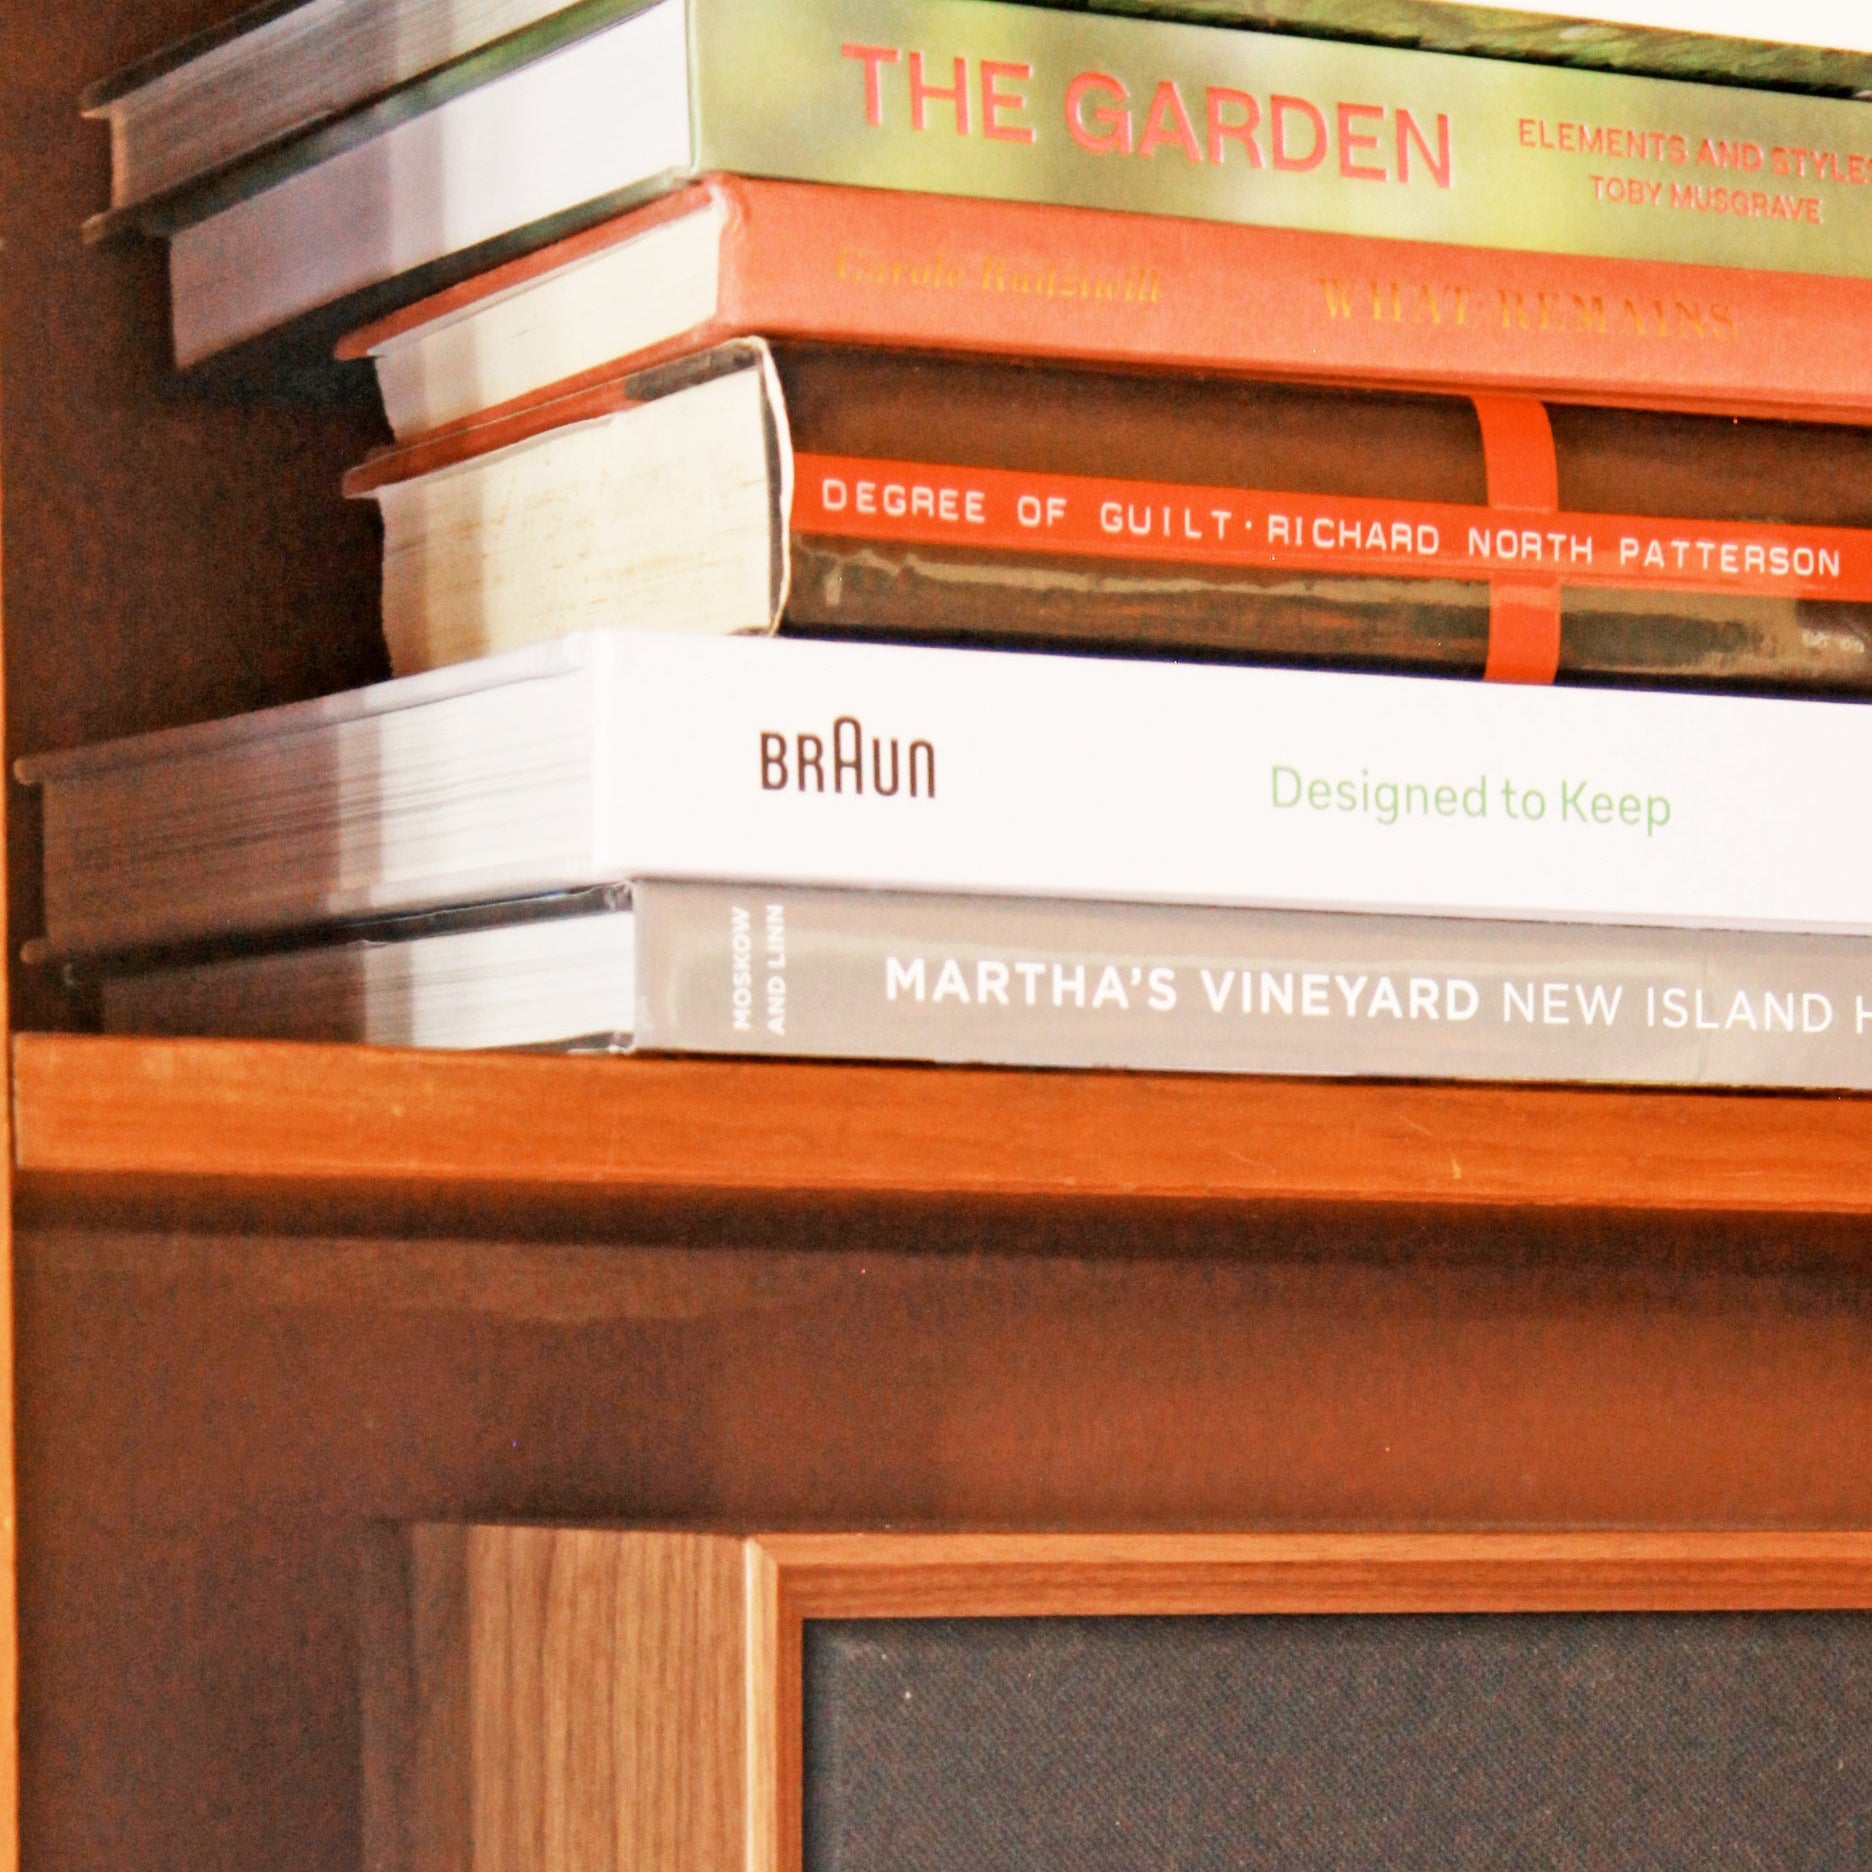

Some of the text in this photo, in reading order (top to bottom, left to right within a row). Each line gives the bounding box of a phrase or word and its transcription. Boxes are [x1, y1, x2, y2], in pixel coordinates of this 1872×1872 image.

[841, 43, 1453, 189] THE GARDEN
[1518, 118, 1689, 166] ELEMENTS
[1698, 138, 1764, 173] AND
[1589, 174, 1823, 225] TOBY MUSGRAVE
[835, 246, 966, 290] Carole
[1317, 275, 1740, 340] WHAT REMAINS
[821, 478, 986, 524] DEGREE
[1017, 495, 1067, 527] OF
[1468, 526, 1594, 565] NORTH
[1619, 536, 1841, 578] PATTERSON
[759, 715, 937, 799] BRAUN
[1271, 765, 1672, 838] Designed to Keep
[731, 905, 752, 1031] MOSKOW
[766, 904, 786, 1036] AND LINN
[885, 957, 1178, 1011] MARTHA'S
[1200, 970, 1480, 1021] VINEYARD
[1502, 980, 1623, 1028] NEW
[1646, 986, 1834, 1034] ISLAND
